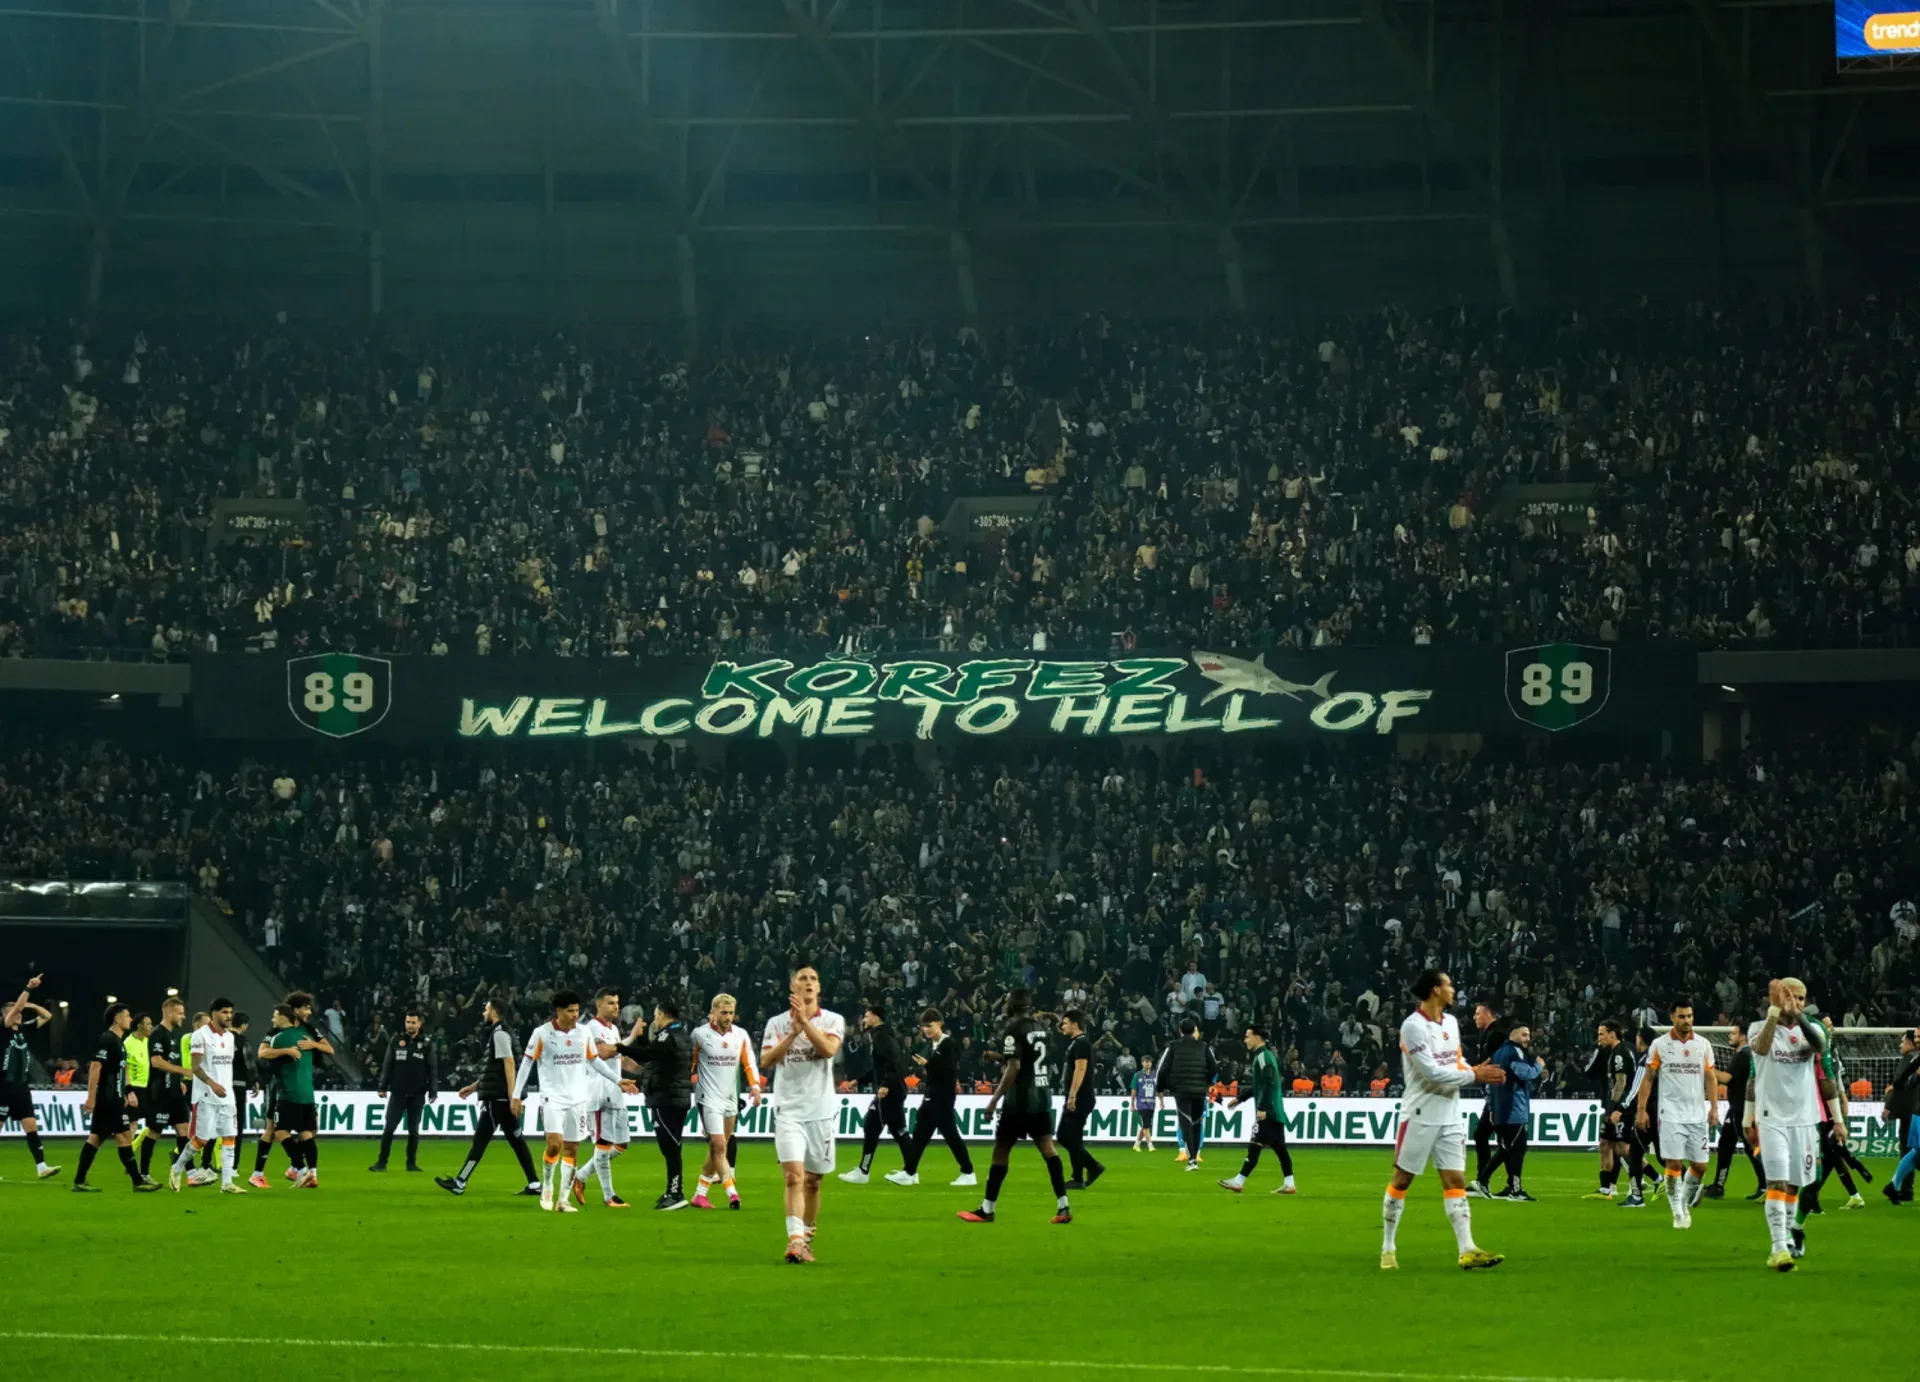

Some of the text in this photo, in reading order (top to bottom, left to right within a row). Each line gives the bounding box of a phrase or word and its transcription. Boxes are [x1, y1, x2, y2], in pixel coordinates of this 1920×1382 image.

[1872, 20, 1920, 40] trend
[304, 672, 373, 712] 89
[701, 652, 1189, 704] KÖRFEZ
[1521, 661, 1593, 705] 89
[459, 690, 1433, 740] WELCOME TO HELL OF
[1033, 1041, 1048, 1075] 2
[825, 1140, 831, 1157] 7
